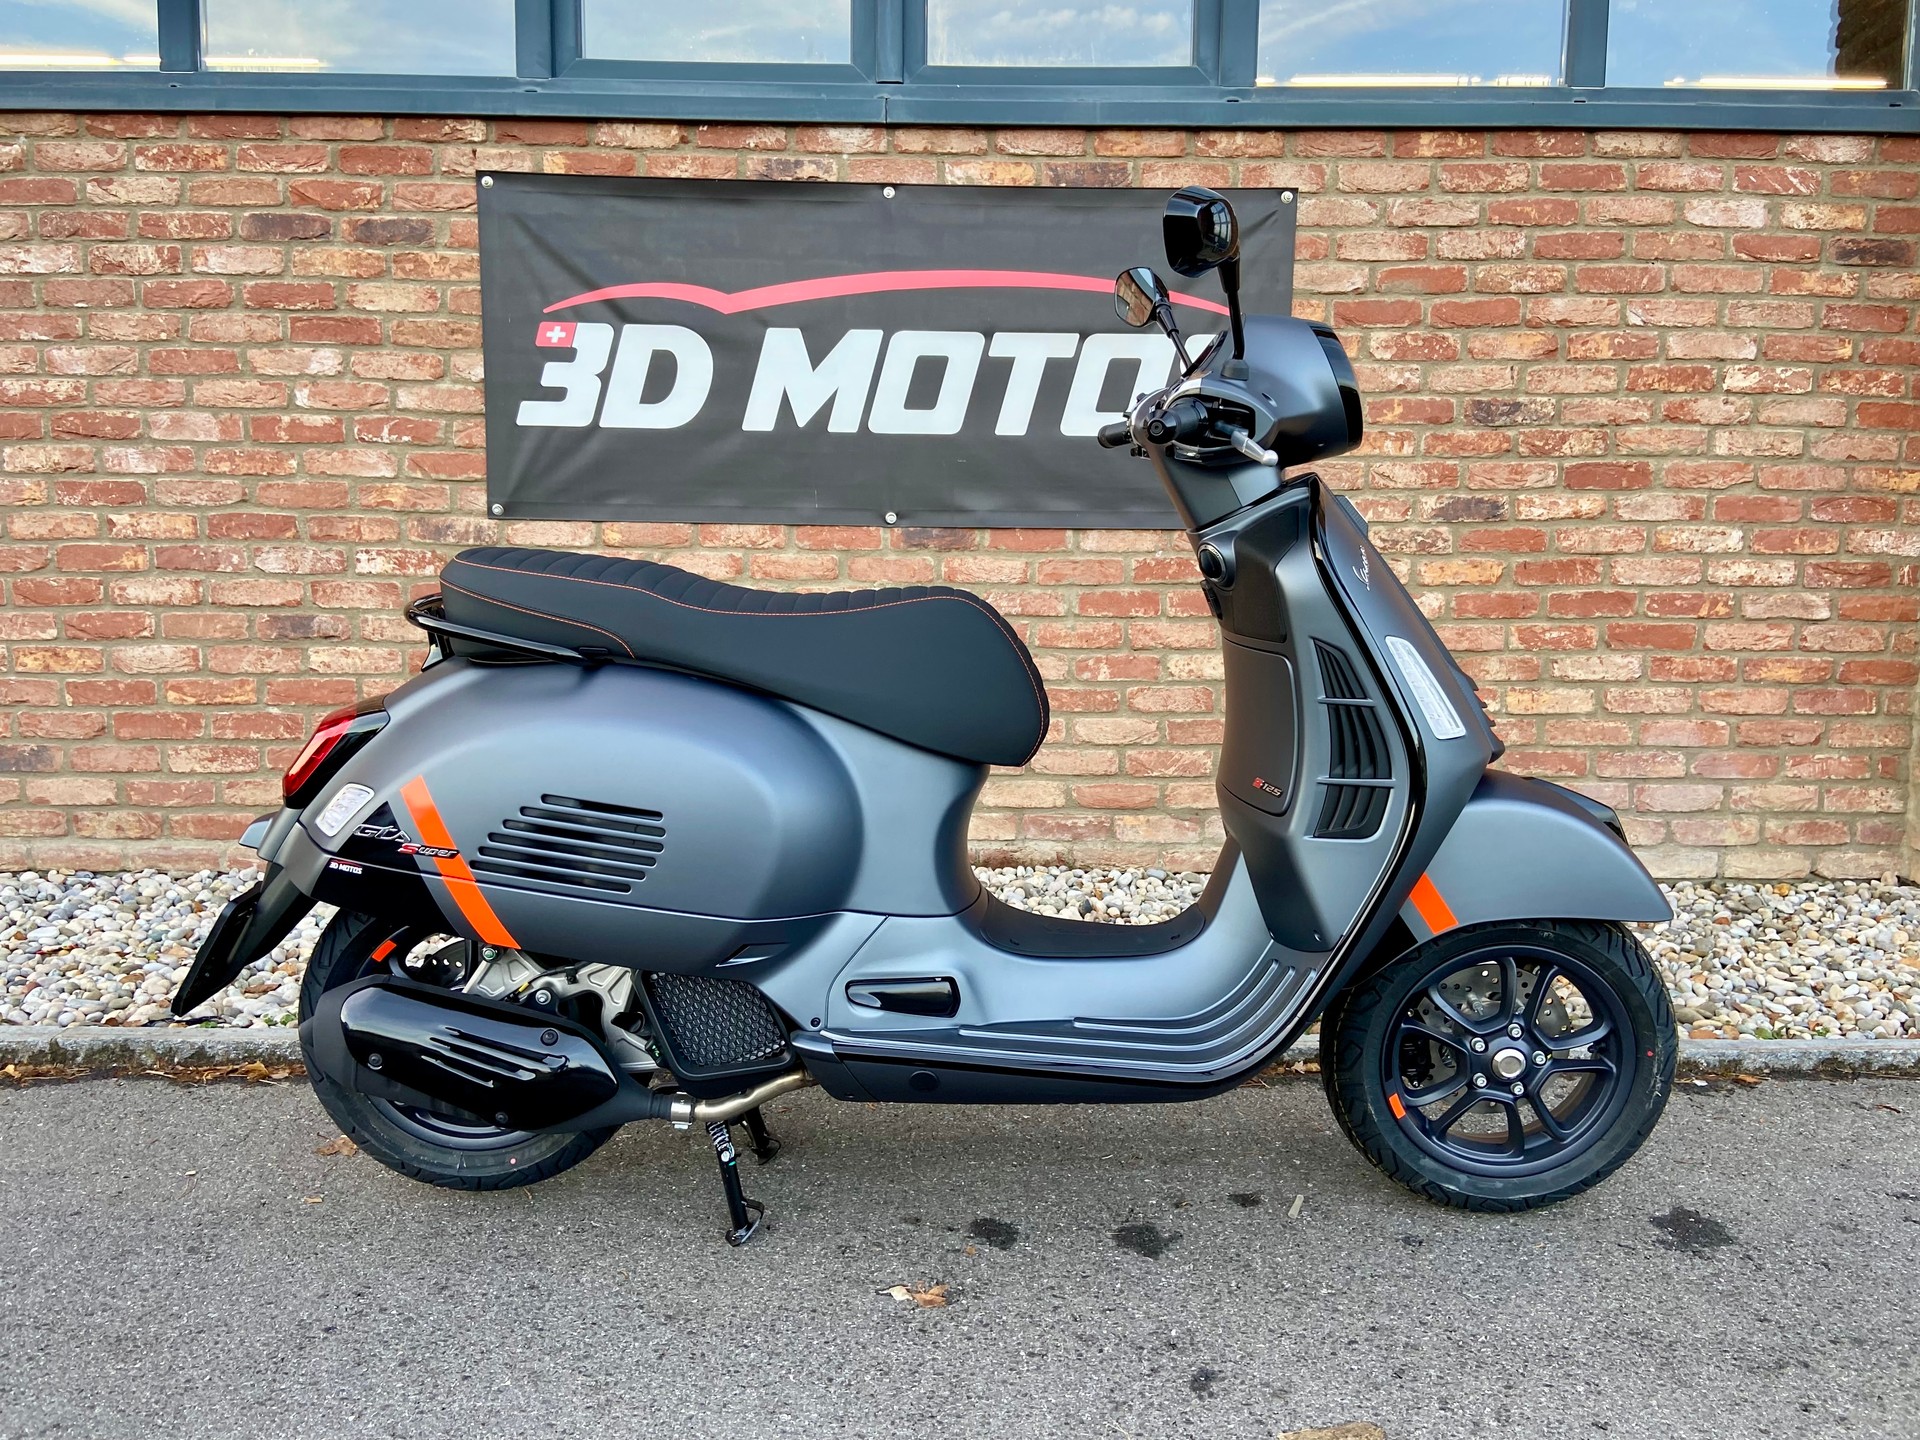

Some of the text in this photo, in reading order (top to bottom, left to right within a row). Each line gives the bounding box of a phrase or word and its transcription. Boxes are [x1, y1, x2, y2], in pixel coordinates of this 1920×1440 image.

[516, 321, 1219, 437] 3D MOTO
[398, 843, 457, 857] Super
[339, 863, 362, 874] MOTOS
